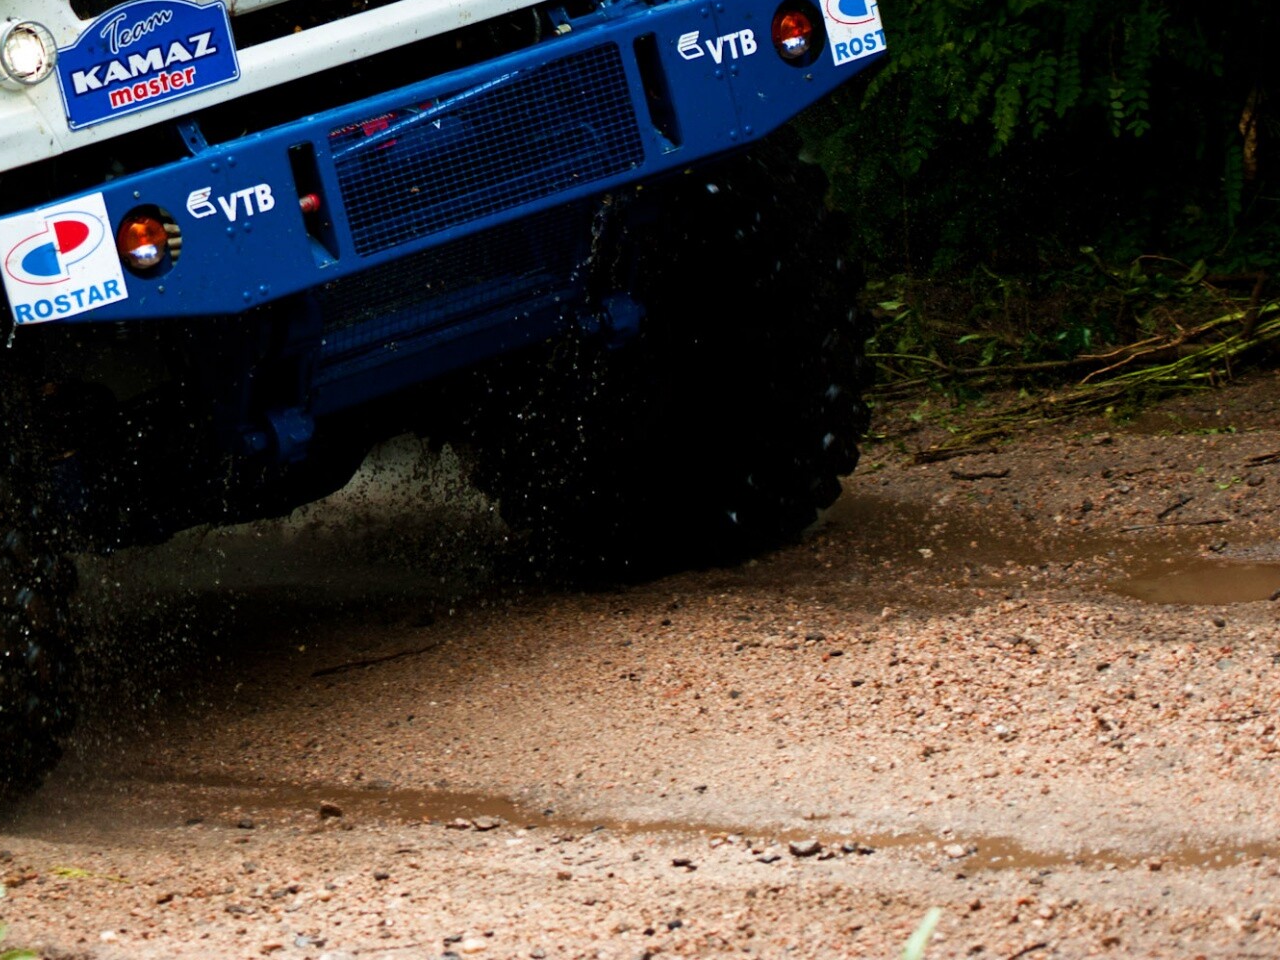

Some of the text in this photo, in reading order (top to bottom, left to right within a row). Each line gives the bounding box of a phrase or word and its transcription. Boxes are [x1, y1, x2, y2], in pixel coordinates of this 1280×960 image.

[101, 7, 173, 55] Team
[705, 27, 758, 65] VTB
[71, 30, 217, 95] KAMAZ
[109, 65, 196, 110] master
[216, 182, 276, 222] VTB
[14, 277, 122, 323] ROSTAR
